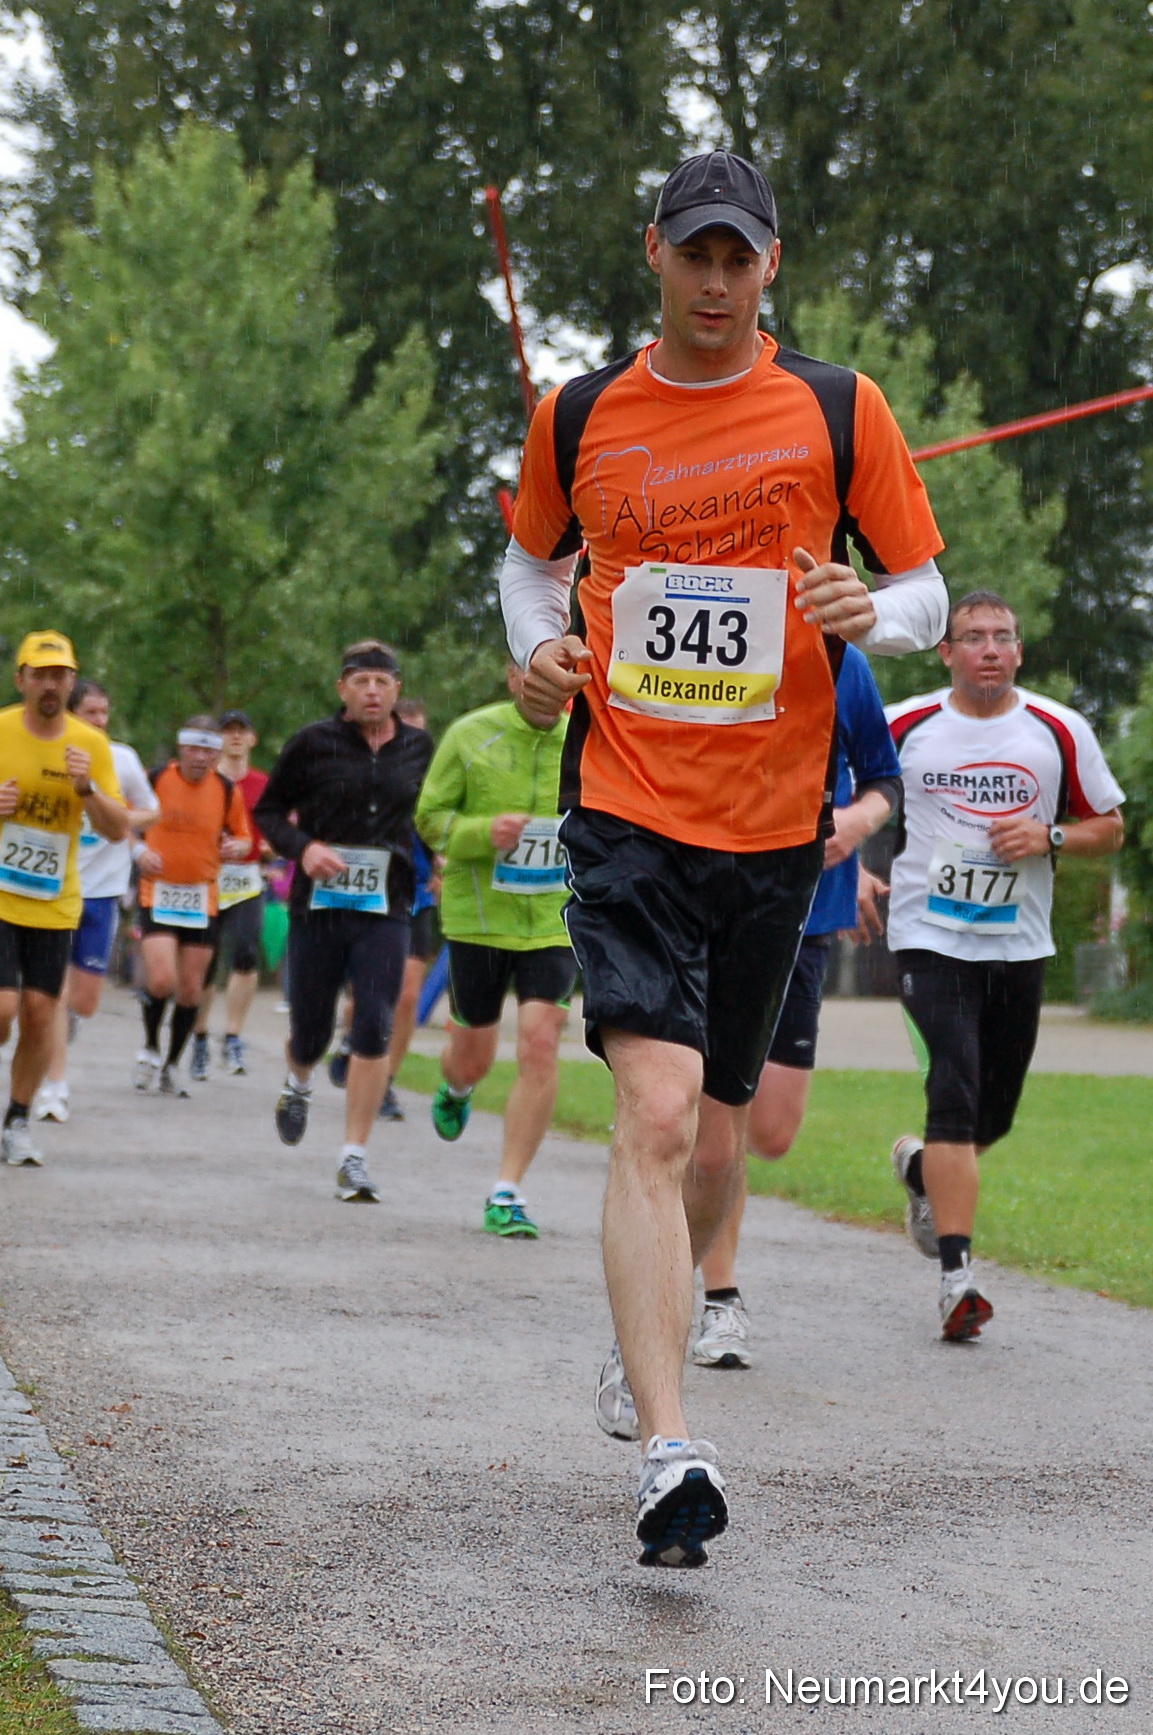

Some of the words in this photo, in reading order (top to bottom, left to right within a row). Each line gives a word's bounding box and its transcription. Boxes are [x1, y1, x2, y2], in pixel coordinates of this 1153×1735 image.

[650, 443, 810, 486] Zahnarztpraxis
[611, 476, 801, 539] Alexander
[638, 518, 790, 565] Schaller
[664, 574, 734, 593] BOCK
[644, 604, 749, 667] 343
[636, 673, 748, 702] Alexander
[922, 772, 1017, 789] GERHART
[966, 789, 1029, 804] JANIG
[3, 842, 60, 876] 2225
[503, 838, 566, 867] 2716
[937, 864, 1019, 903] 3177
[160, 889, 202, 910] 3228
